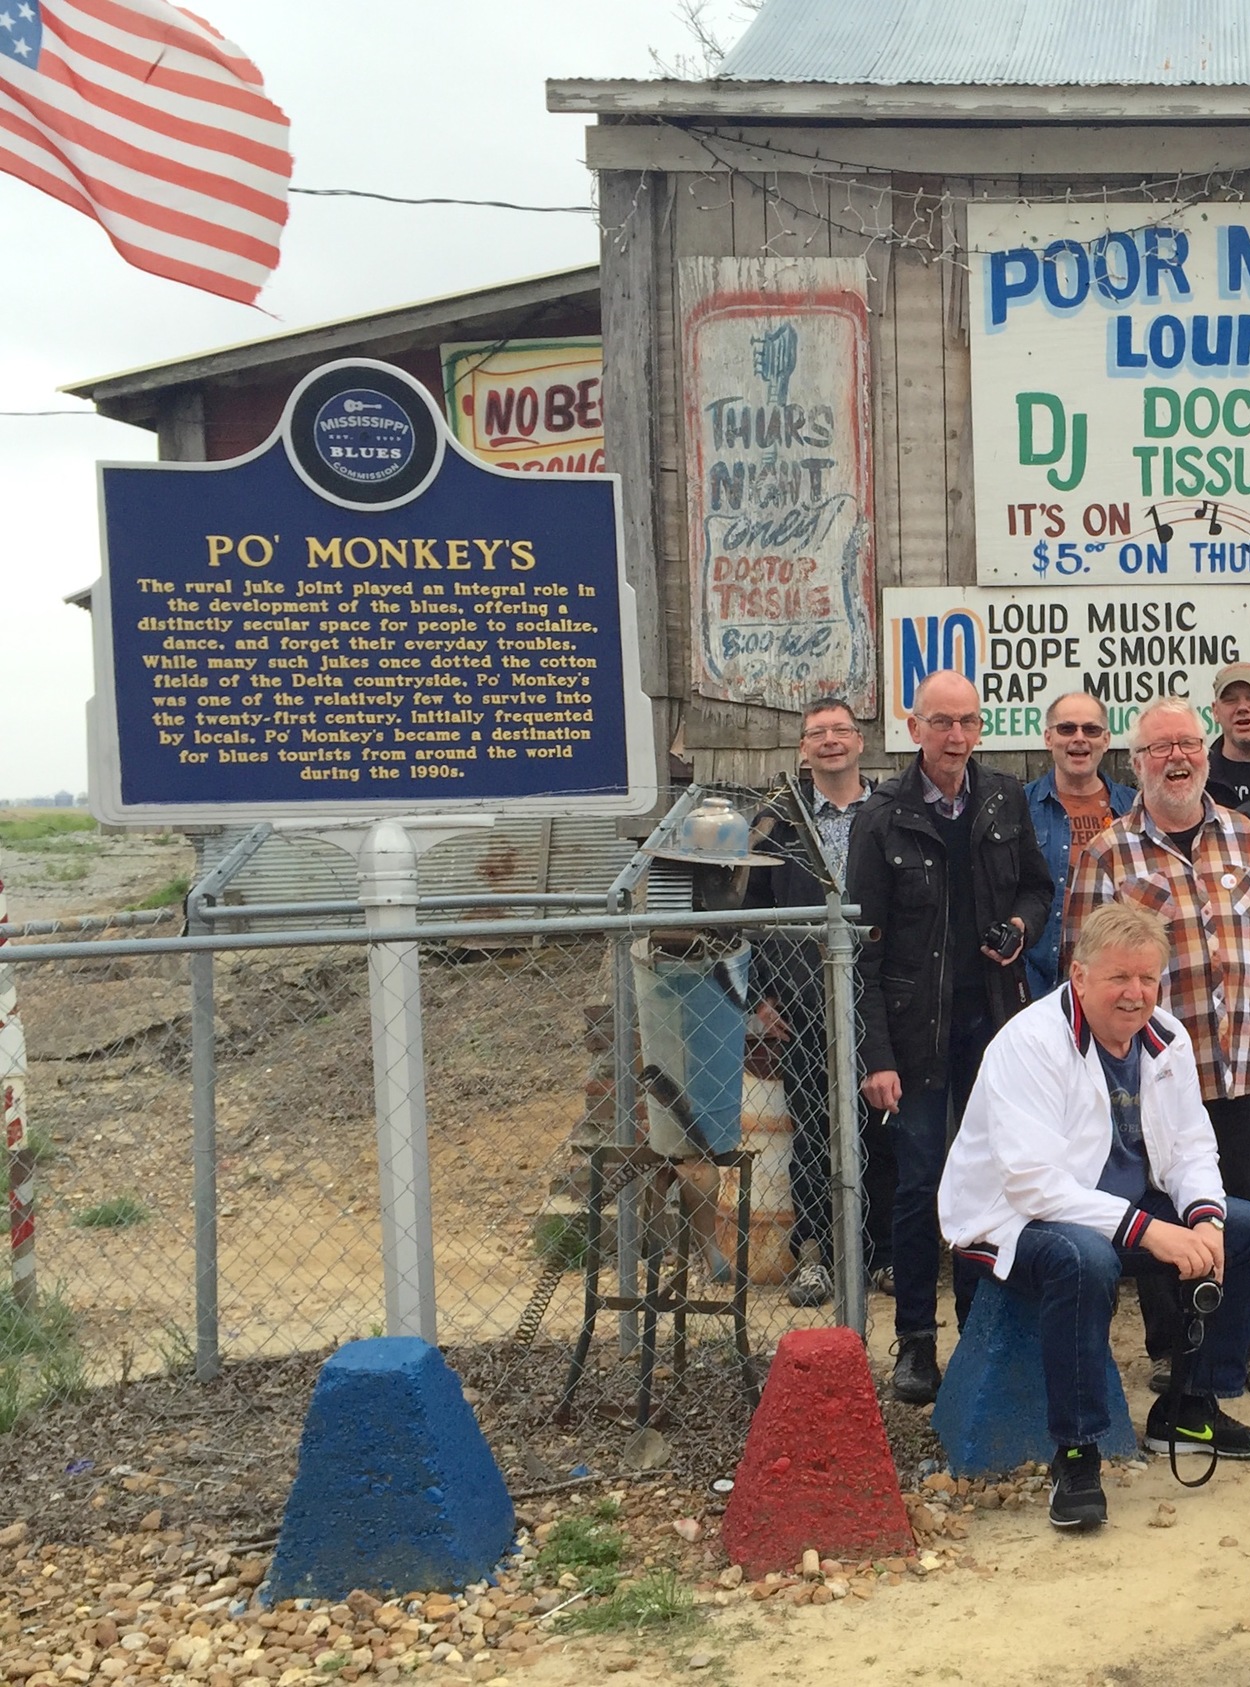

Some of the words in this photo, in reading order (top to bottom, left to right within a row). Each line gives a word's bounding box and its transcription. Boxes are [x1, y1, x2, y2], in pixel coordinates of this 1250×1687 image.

[988, 226, 1193, 327] POOR
[484, 386, 539, 437] NO
[320, 416, 409, 434] MISSISSIPPI
[704, 396, 835, 451] THURS
[1015, 391, 1088, 492] DJ
[329, 446, 402, 459] BLUES
[333, 462, 400, 480] COMMISSION
[1007, 502, 1066, 538] IT'S
[1082, 501, 1131, 537] ON
[205, 534, 280, 567] PO'
[305, 536, 537, 571] MONKEY'S
[1118, 541, 1168, 575] ON
[137, 578, 175, 593] The
[185, 579, 233, 594] rural
[244, 580, 285, 598] juke
[296, 581, 343, 598] joint
[352, 581, 414, 598] played
[422, 584, 445, 596] an
[454, 582, 526, 601] integral
[533, 583, 569, 597] role
[577, 584, 596, 598] in
[167, 598, 200, 612] the
[208, 598, 328, 615] development
[337, 599, 359, 614] of
[370, 599, 401, 614] the
[410, 600, 464, 614] blues,
[474, 600, 549, 619] offering
[557, 604, 569, 615] a
[137, 617, 233, 633] distinctly
[242, 617, 310, 632] secular
[319, 620, 371, 634] space
[380, 618, 408, 632] for
[417, 618, 477, 635] people
[486, 619, 507, 632] to
[516, 618, 597, 633] socialize,
[163, 636, 224, 651] dance,
[235, 636, 269, 651] and
[280, 636, 339, 653] forget
[349, 636, 396, 651] their
[404, 637, 487, 653] everyday
[497, 636, 576, 652] troubles.
[990, 636, 1081, 671] DOPE
[1097, 635, 1240, 669] SMOKING
[143, 655, 198, 670] While
[207, 657, 257, 671] many
[268, 655, 309, 669] such
[320, 655, 369, 673] jukes
[379, 658, 421, 669] once
[430, 654, 493, 669] dotted
[501, 655, 531, 669] the
[539, 655, 597, 669] cotton
[900, 612, 977, 710] NO
[987, 603, 1069, 635] LOUD
[1087, 601, 1198, 634] MUSIC
[153, 674, 209, 689] fields
[219, 674, 240, 688] of
[250, 674, 282, 688] the
[292, 673, 344, 688] Delta
[353, 673, 467, 689] countryside,
[477, 673, 499, 687] Po'
[511, 672, 590, 688] Monkey's
[982, 672, 1048, 703] RAP
[1083, 670, 1189, 703] MUSIC
[153, 696, 187, 707] was
[197, 695, 231, 707] one
[242, 692, 263, 706] of
[274, 693, 304, 707] the
[314, 692, 404, 708] relatively
[413, 691, 444, 706] few
[453, 692, 473, 705] to
[482, 691, 546, 706] survive
[555, 691, 592, 705] into
[152, 712, 185, 727] the
[196, 711, 316, 726] twenty-first
[324, 711, 402, 725] century.
[410, 710, 484, 725] Initially
[494, 709, 594, 728] frequented
[980, 705, 1042, 737] BEER
[159, 731, 184, 747] by
[194, 730, 256, 745] locals,
[265, 729, 289, 743] Po'
[301, 729, 384, 745] Monkey's
[394, 728, 461, 743] became
[470, 730, 482, 742] a
[491, 727, 591, 742] destination
[179, 750, 209, 763] for
[219, 748, 269, 764] blues
[278, 749, 351, 763] tourists
[362, 748, 406, 762] from
[414, 746, 478, 761] around
[487, 745, 517, 759] the
[526, 744, 573, 759] world
[300, 766, 360, 782] during
[369, 766, 400, 780] the
[410, 764, 464, 779] 1990s.
